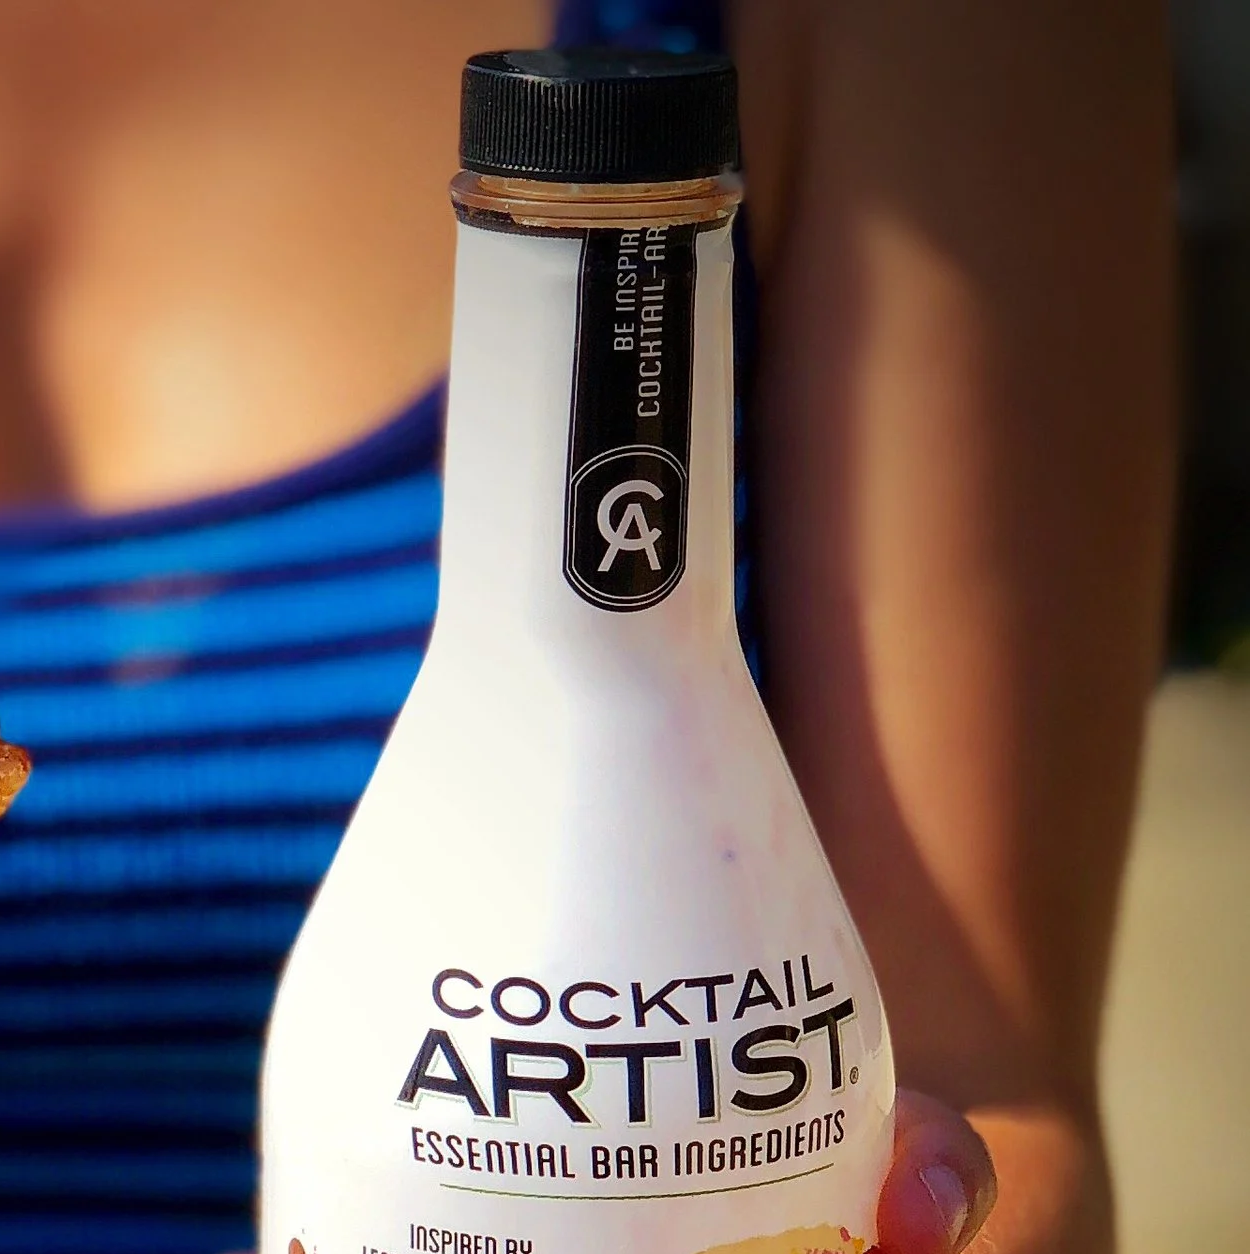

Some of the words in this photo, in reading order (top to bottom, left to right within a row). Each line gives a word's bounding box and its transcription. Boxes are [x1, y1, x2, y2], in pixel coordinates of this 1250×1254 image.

[613, 322, 635, 351] BE
[431, 954, 835, 1030] COCKTAIL
[411, 1127, 576, 1180] ESSENTIAL
[592, 1145, 659, 1180] BAR
[673, 1109, 847, 1177] INGREDIENTS
